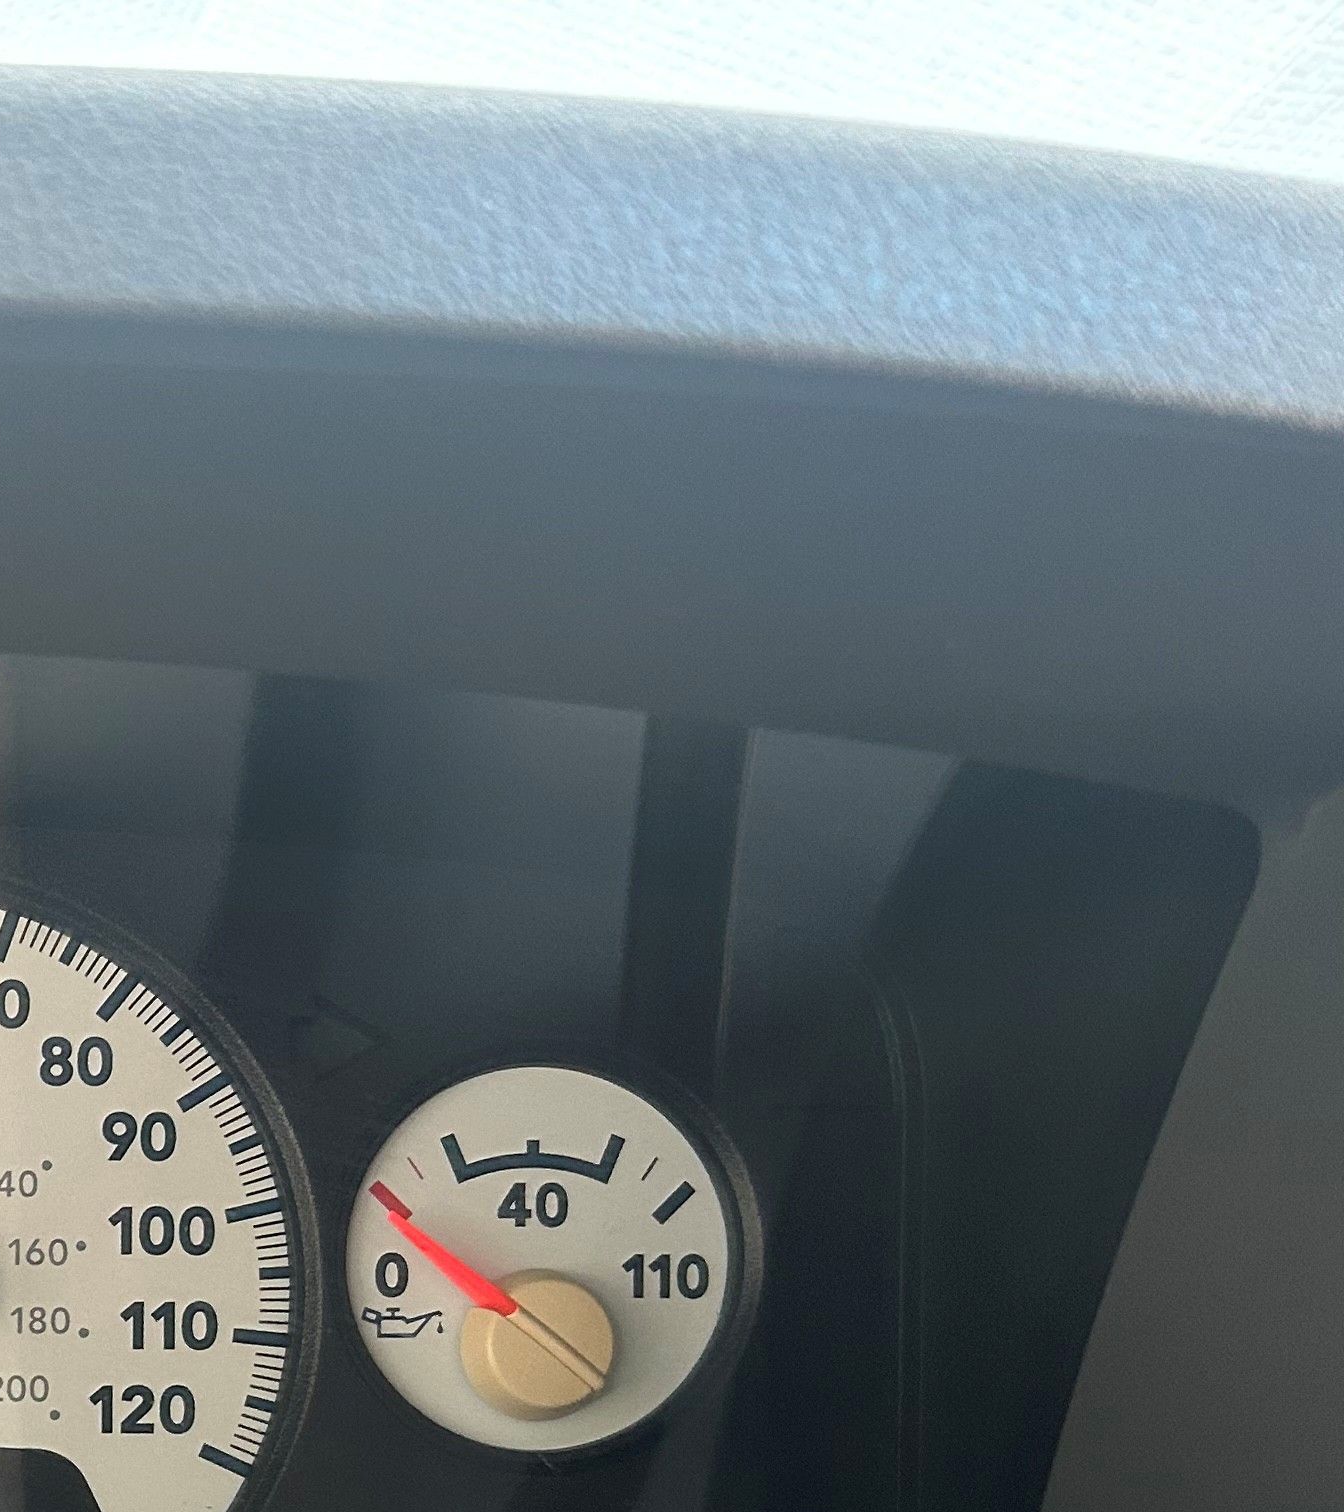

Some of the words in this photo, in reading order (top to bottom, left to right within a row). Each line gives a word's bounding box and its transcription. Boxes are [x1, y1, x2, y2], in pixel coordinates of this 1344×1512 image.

[40, 1037, 113, 1086] 80
[102, 1112, 177, 1161] 90
[498, 1183, 568, 1228] 40
[8, 1239, 68, 1266] 160
[108, 1206, 215, 1256] 100
[375, 1253, 408, 1297] 0
[622, 1254, 709, 1299] 110
[11, 1307, 70, 1334] 180
[120, 1301, 218, 1350] 110
[90, 1385, 195, 1434] 120
